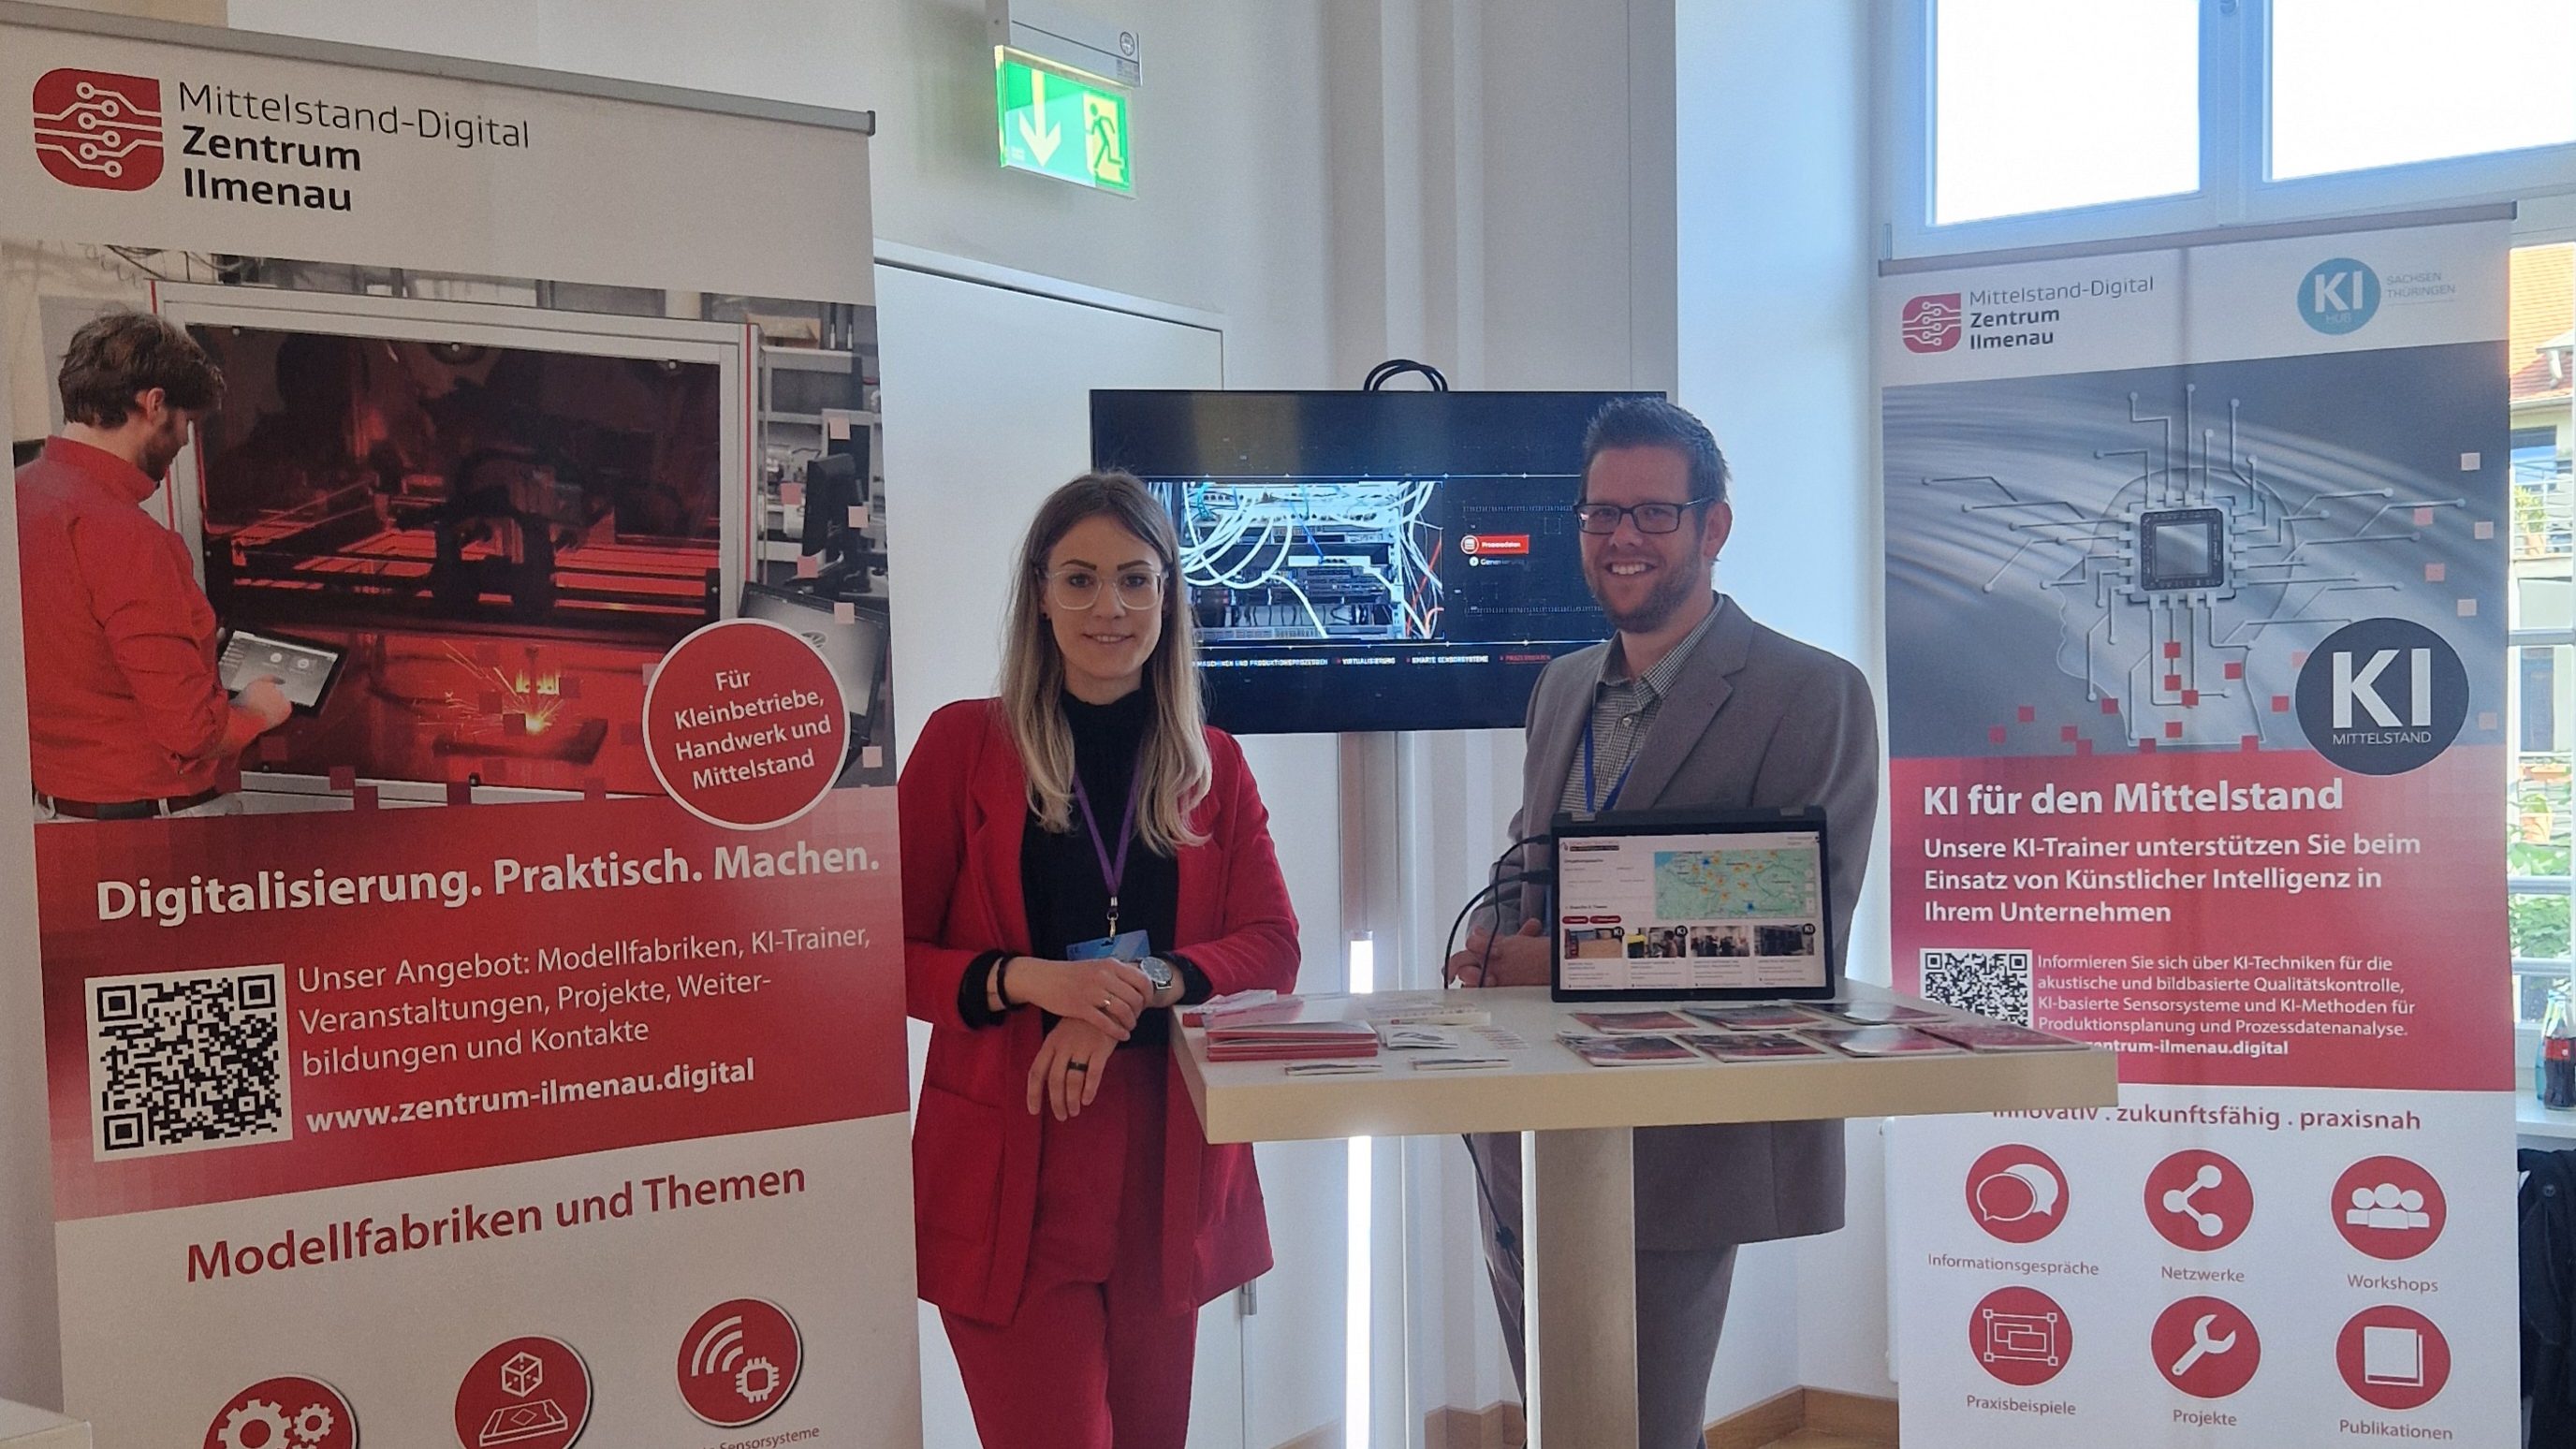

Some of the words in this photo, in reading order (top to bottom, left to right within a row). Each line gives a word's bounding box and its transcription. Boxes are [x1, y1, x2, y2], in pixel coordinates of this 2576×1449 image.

[179, 81, 529, 149] Mittelstand-Digital
[183, 125, 361, 170] Zentrum
[184, 168, 352, 211] Ilmenau
[1969, 276, 2154, 307] Mittelstand-Digital
[2388, 272, 2441, 285] SACHSEN
[2315, 271, 2364, 313] KI
[1969, 306, 2060, 328] Zentrum
[2325, 313, 2351, 324] HUB
[1969, 329, 2055, 350] Ilmenau
[715, 668, 751, 691] Für
[2333, 648, 2432, 729] KI
[675, 691, 824, 730] Kleinbetriebe,
[675, 725, 788, 761] Handwerk
[791, 715, 831, 739] und
[2333, 730, 2432, 745] MITTELSTAND
[693, 749, 814, 789] Mittelstand
[1924, 786, 1958, 815] KI
[1968, 783, 2022, 815] für
[2030, 783, 2102, 814] den
[2114, 777, 2343, 812] Mittelstand
[1924, 838, 2006, 858] Unsere
[2012, 837, 2130, 857] KI-Trainer
[2136, 835, 2300, 856] unterstützen
[2307, 834, 2346, 855] Sie
[2354, 832, 2421, 855] beim
[97, 868, 482, 928] Digitalisierung.
[494, 848, 703, 894] Praktisch.
[714, 841, 880, 880] Machen.
[1925, 870, 2008, 889] Einsatz
[2013, 873, 2058, 889] von
[2066, 868, 2206, 889] Künstlicher
[2213, 868, 2350, 894] Intelligenz
[2358, 867, 2382, 888] in
[1925, 901, 1993, 922] Ihrem
[2000, 900, 2172, 922] Unternehmen
[299, 967, 387, 992] Unser
[395, 952, 530, 988] Angebot:
[537, 936, 745, 973] Modellfabriken,
[752, 926, 871, 955] KI-Trainer,
[2038, 955, 2127, 970] Informieren
[2130, 955, 2154, 970] Sie
[2158, 955, 2188, 970] sich
[2192, 956, 2230, 970] über
[2233, 956, 2335, 971] KI-Techniken
[2339, 956, 2364, 971] für
[2366, 957, 2393, 971] die
[2038, 976, 2117, 990] akustische
[2121, 976, 2153, 990] und
[2157, 976, 2249, 991] bildbasierte
[2253, 976, 2405, 994] Qualitätskontrolle,
[299, 993, 549, 1034] Veranstaltungen,
[558, 979, 671, 1014] Projekte,
[677, 972, 771, 998] Weiter-
[2038, 997, 2119, 1011] KI-basierte
[2123, 997, 2240, 1015] Sensorsysteme
[2245, 999, 2276, 1013] und
[2280, 999, 2387, 1014] KI-Methoden
[2391, 1000, 2415, 1015] für
[2039, 1017, 2196, 1036] Produktionsplanung
[2201, 1019, 2231, 1033] und
[2235, 1019, 2408, 1039] Prozessdatenanalyse.
[303, 1043, 458, 1076] bildungen
[467, 1030, 521, 1059] und
[531, 1020, 649, 1053] Kontakte
[306, 1058, 754, 1133] www.zentrum-ilmenau.digital
[2116, 1104, 2280, 1130] zukunftsfähig
[2300, 1107, 2421, 1132] praxisnah
[187, 1204, 542, 1282] Modellfabriken
[555, 1181, 635, 1227] und
[641, 1167, 806, 1214] Themen
[1927, 1252, 2100, 1277] Informationsgespräche
[2160, 1266, 2245, 1284] Netzwerke
[2347, 1273, 2439, 1294] Workshops
[1966, 1394, 2076, 1416] Praxisbeispiele
[2173, 1409, 2238, 1429] Projekte
[2339, 1420, 2452, 1442] Publikationen
